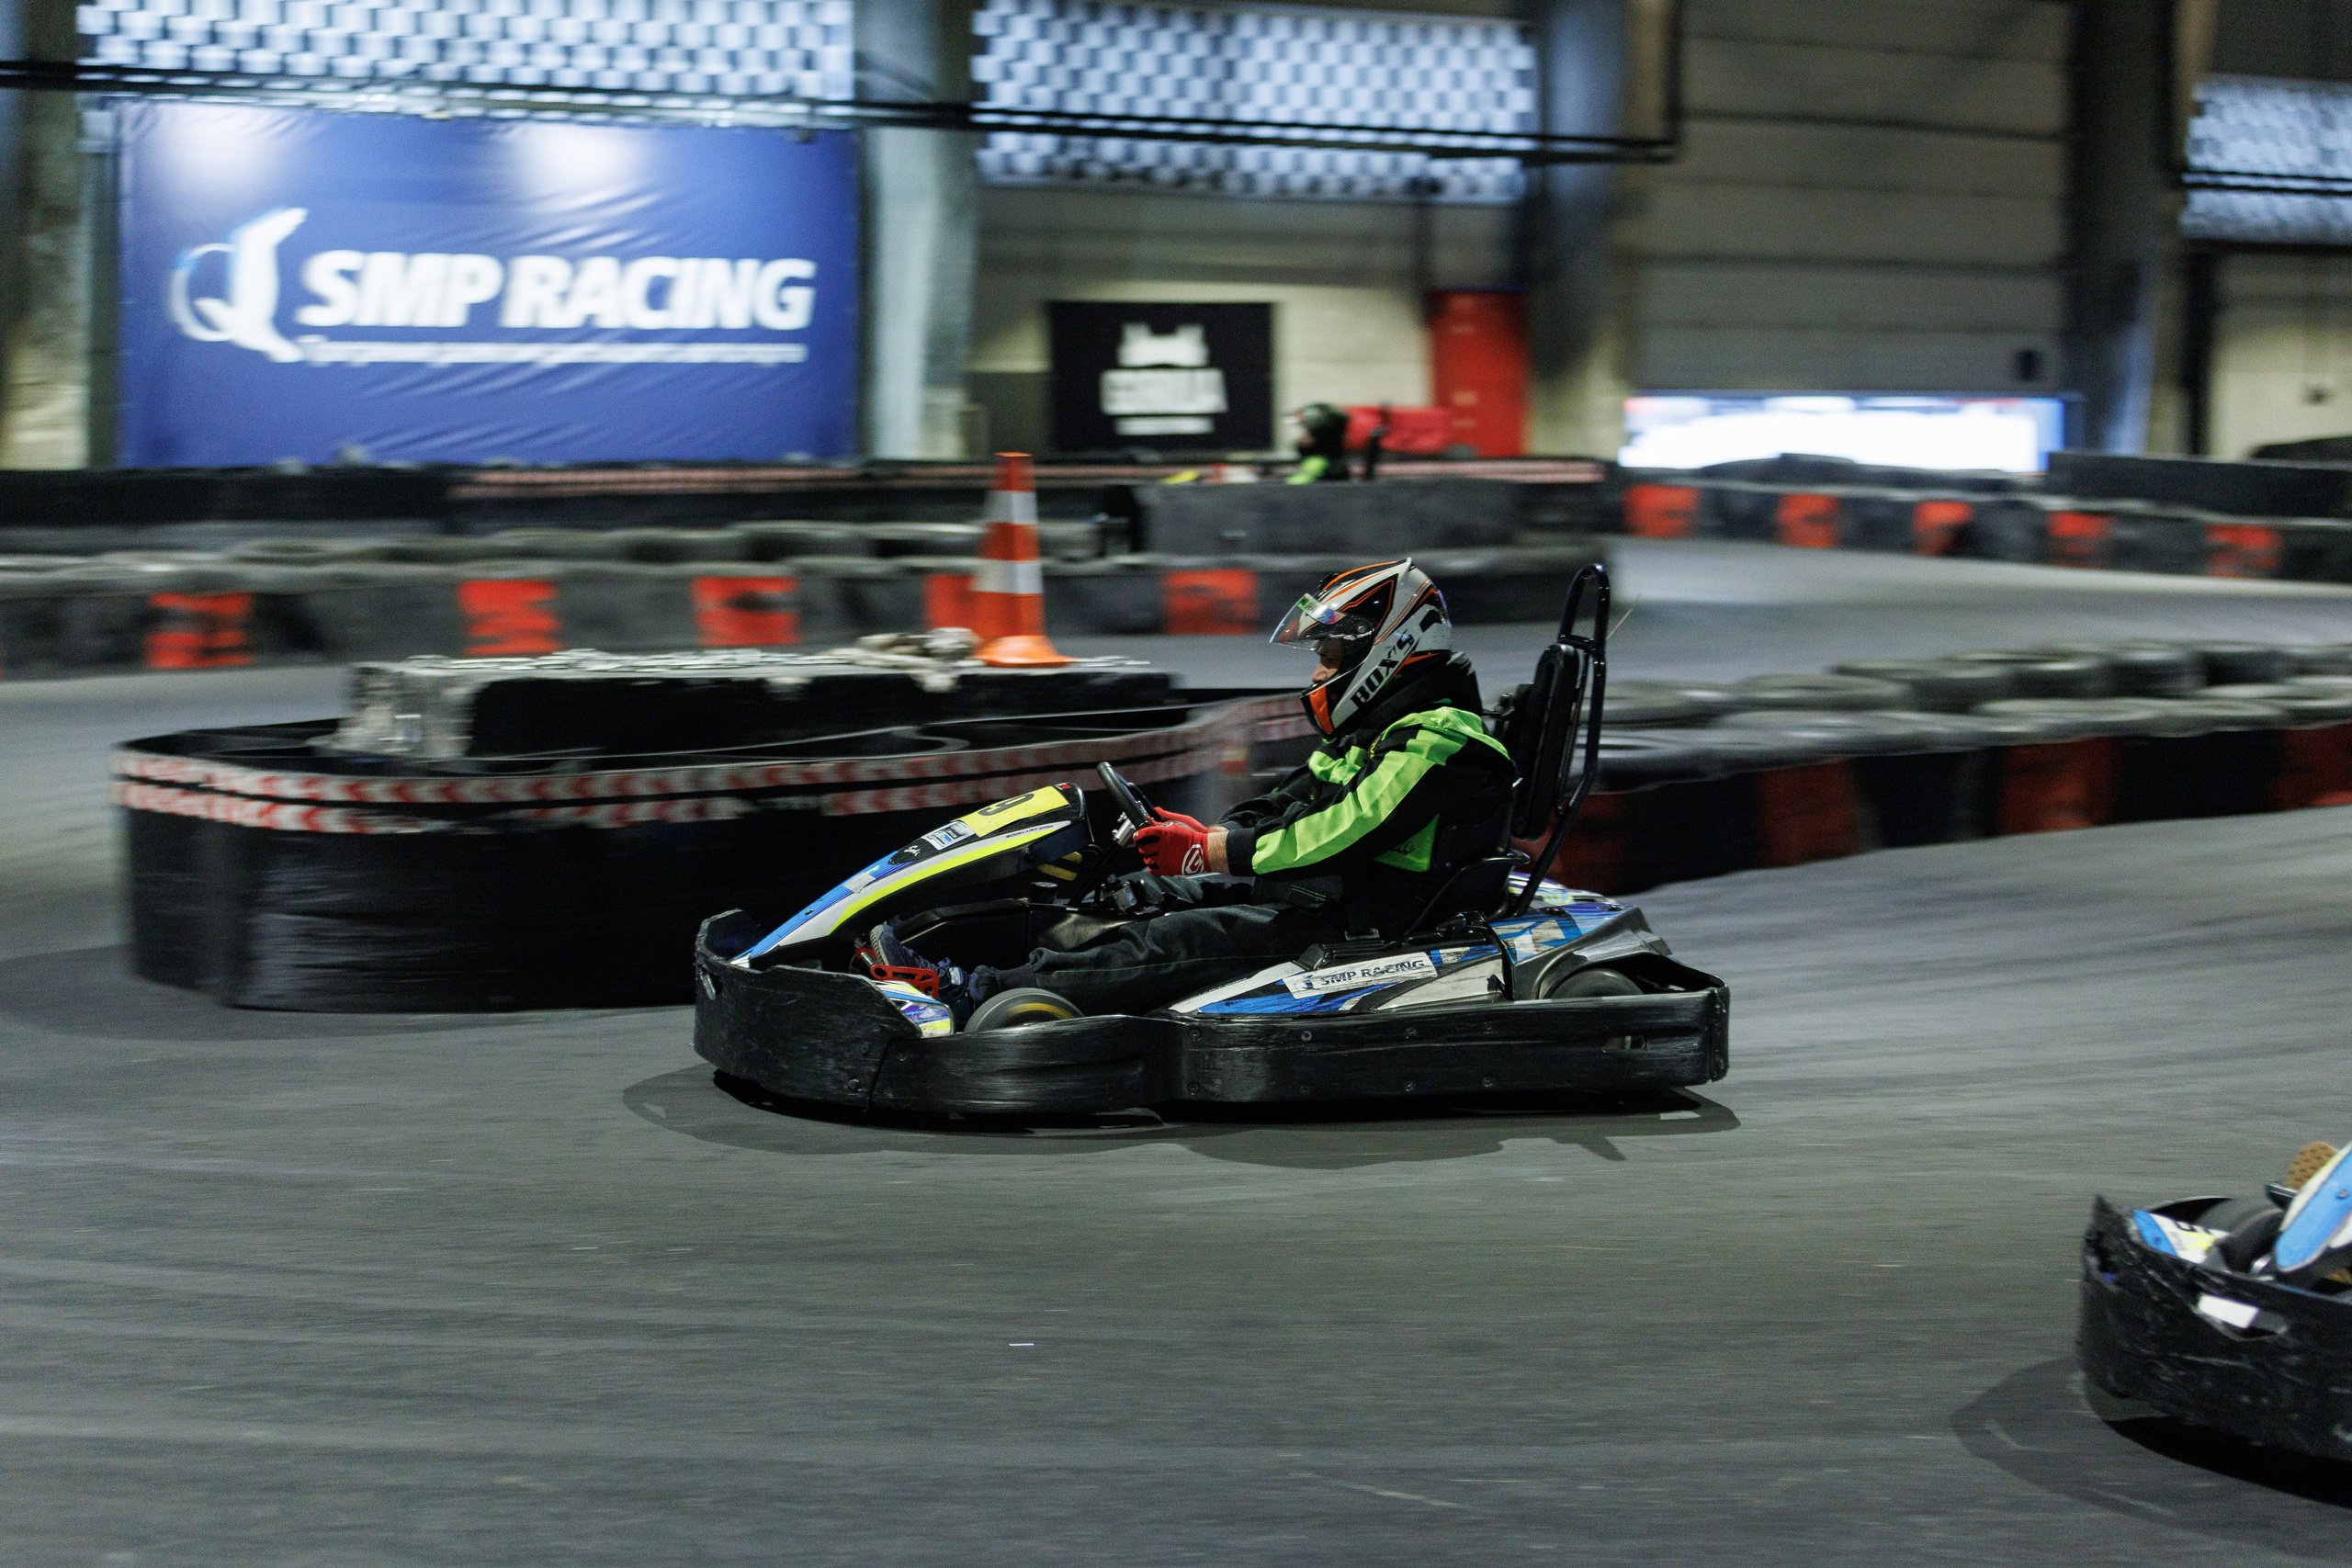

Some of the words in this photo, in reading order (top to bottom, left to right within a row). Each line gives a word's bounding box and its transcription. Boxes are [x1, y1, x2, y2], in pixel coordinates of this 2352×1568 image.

[296, 250, 503, 326] SMP
[501, 256, 816, 330] RACING
[978, 794, 1034, 816] 9
[1321, 971, 1356, 985] SMP
[1362, 960, 1424, 977] RACING
